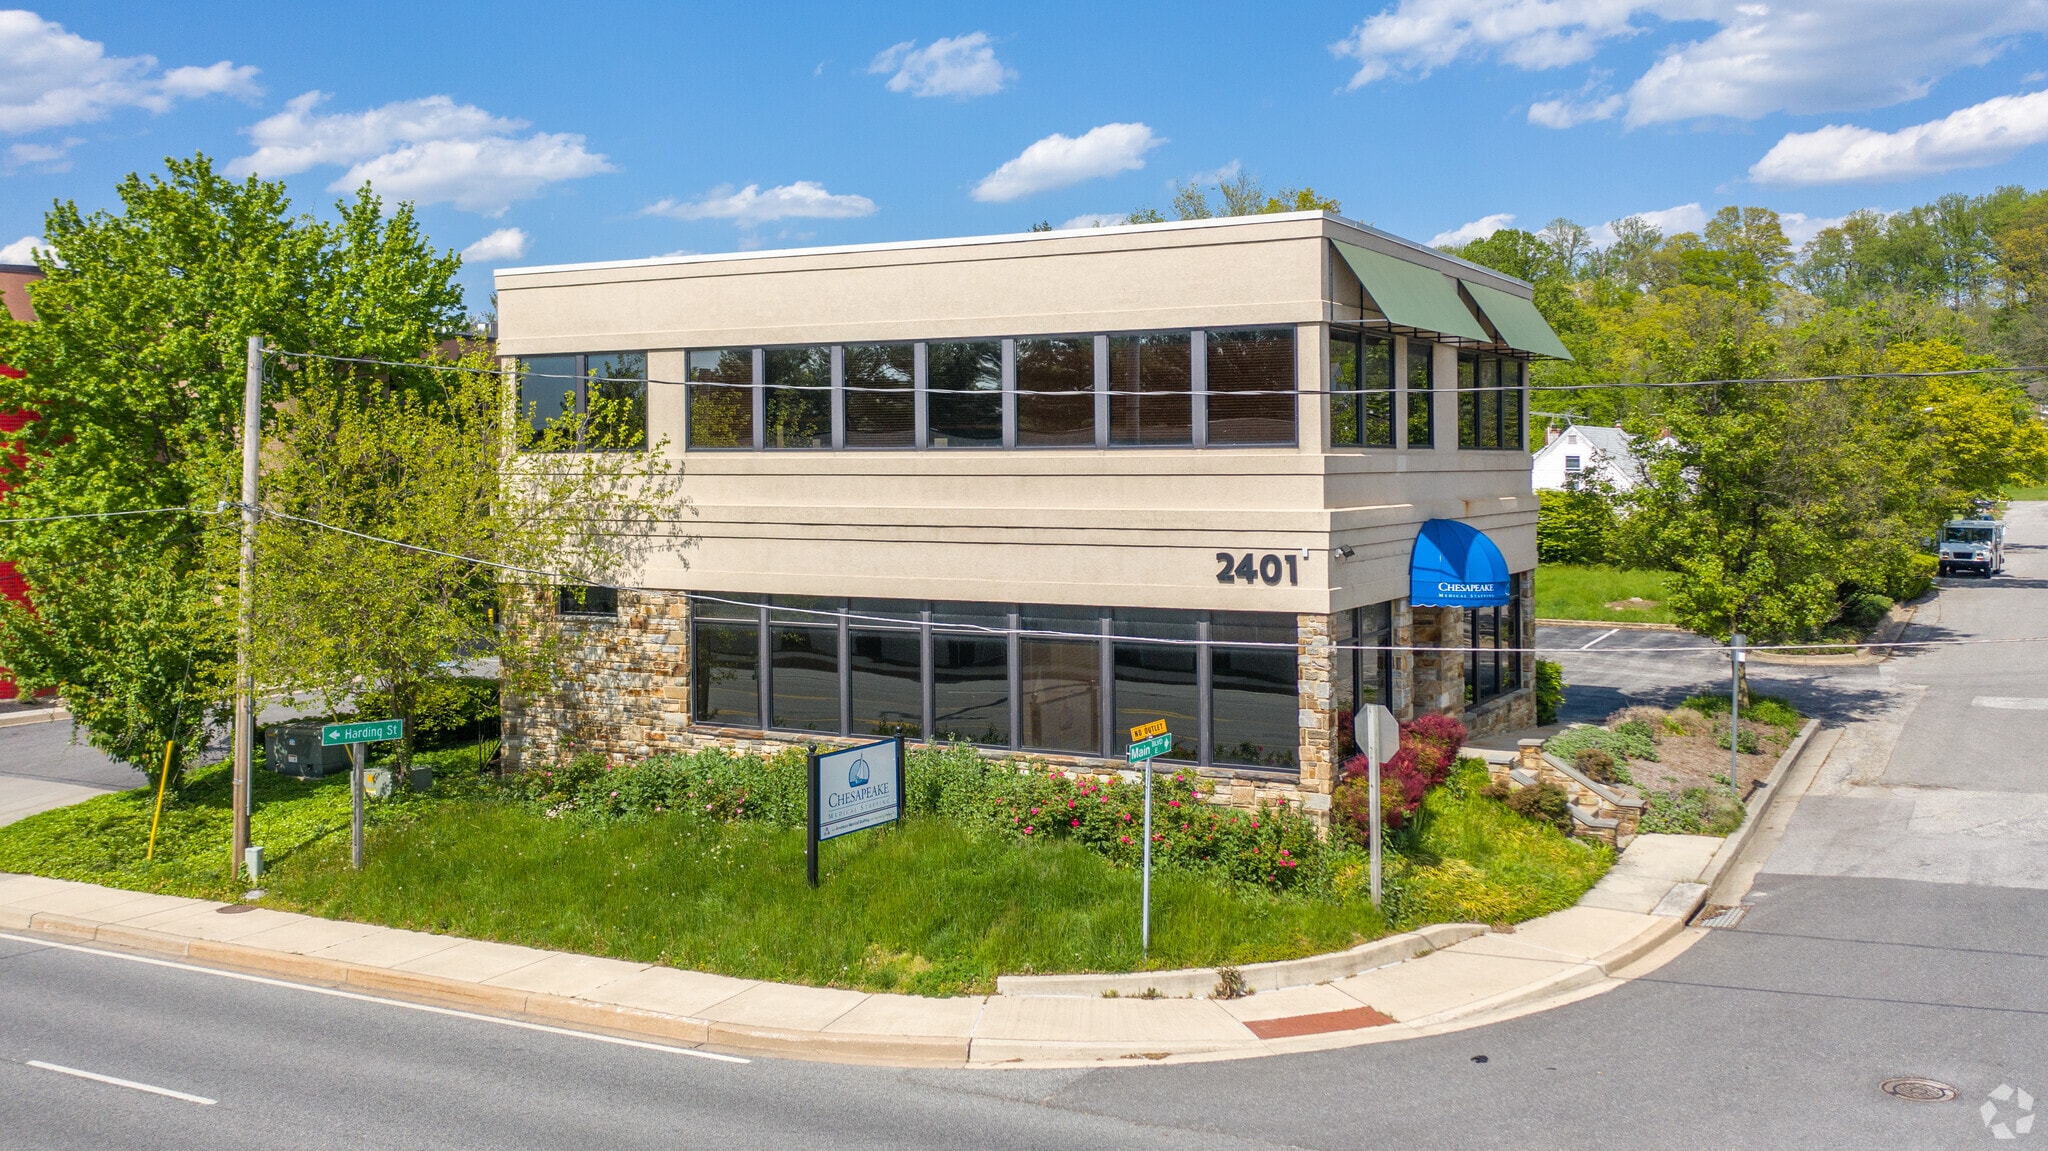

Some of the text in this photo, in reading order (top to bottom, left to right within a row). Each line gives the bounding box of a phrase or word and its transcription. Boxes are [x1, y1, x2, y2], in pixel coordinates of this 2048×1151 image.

[1216, 552, 1298, 586] 2401
[1438, 582, 1494, 592] CHESAPEAKE
[345, 725, 397, 739] Harding St
[1144, 723, 1163, 734] OUTLET
[1131, 739, 1163, 759] Main BLVD
[829, 783, 889, 808] CHESAPEAKE
[828, 801, 889, 819] MEDICAL STAFFING
